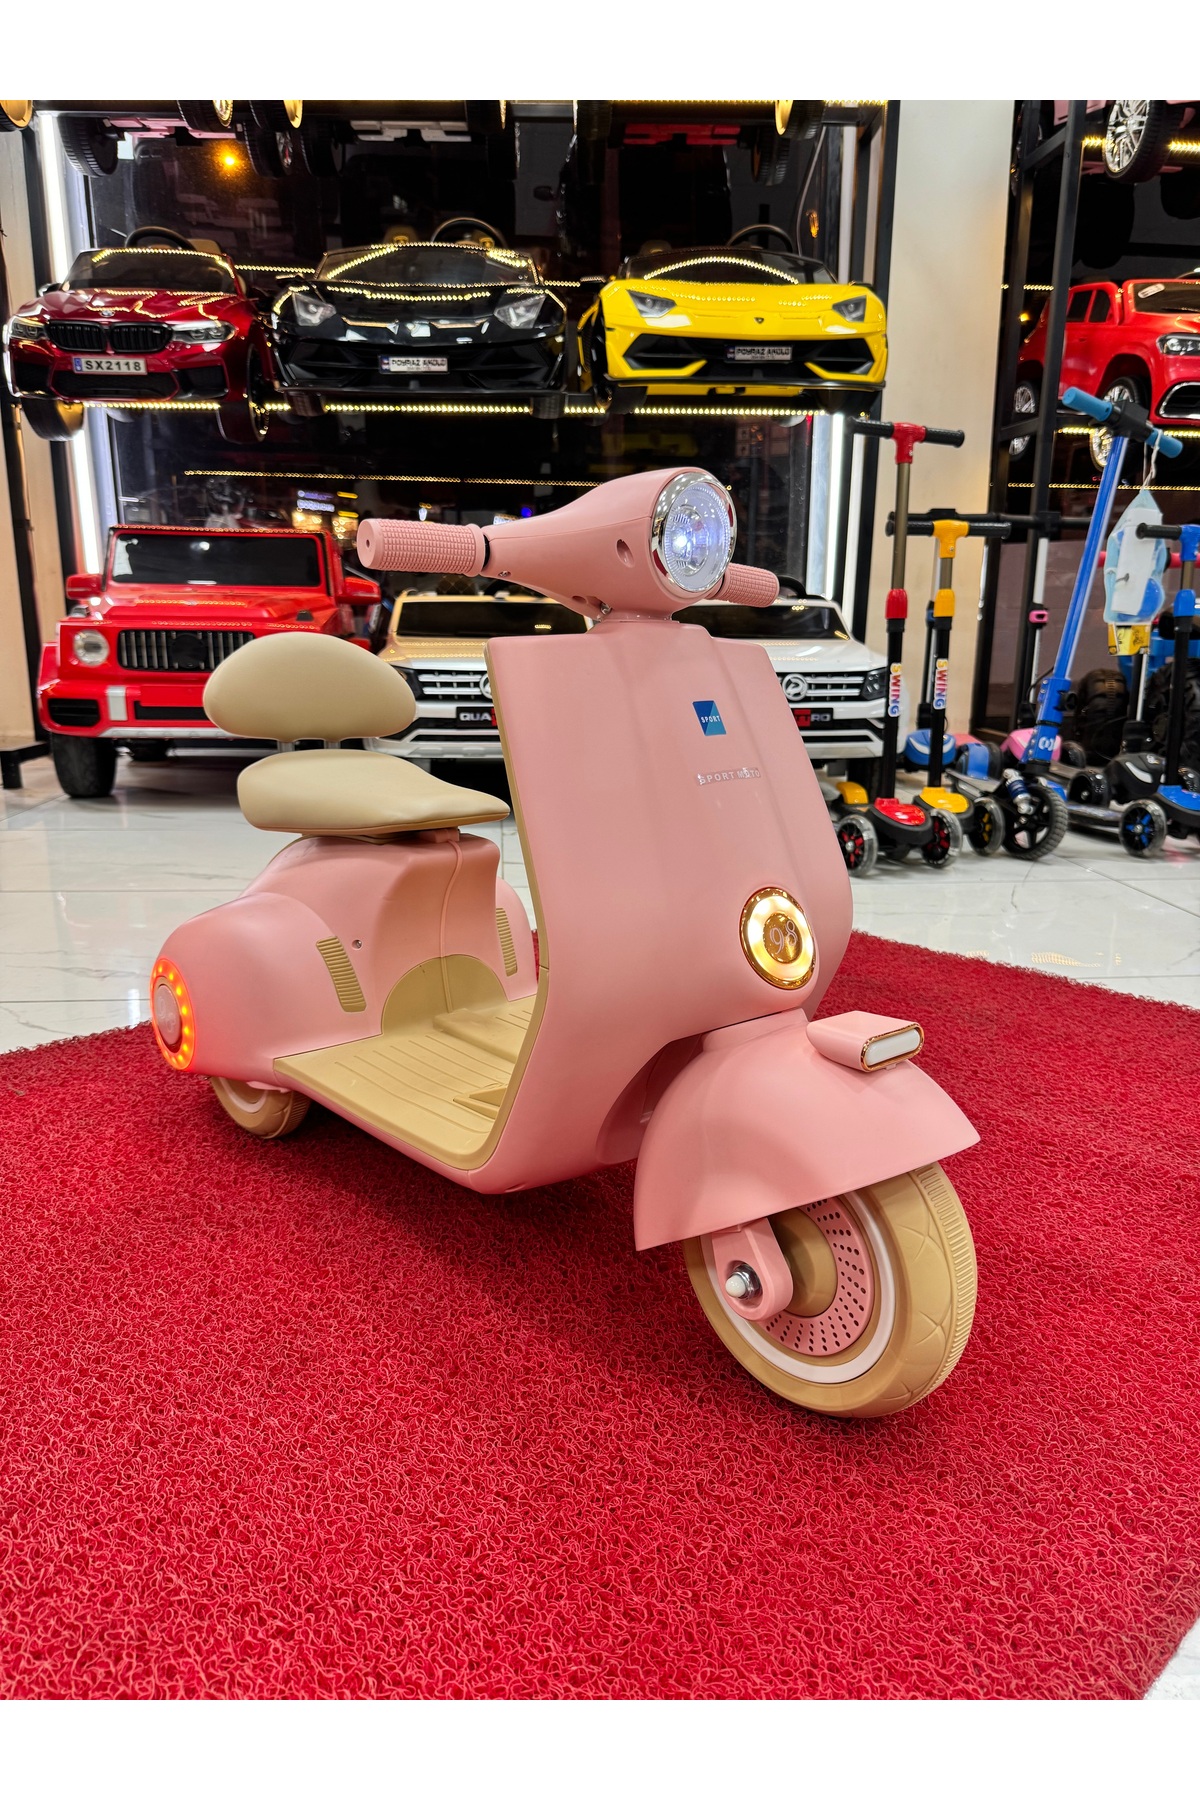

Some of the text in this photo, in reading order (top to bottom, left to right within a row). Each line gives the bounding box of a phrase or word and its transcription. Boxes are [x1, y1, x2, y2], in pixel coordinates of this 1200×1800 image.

[85, 360, 141, 371] SX2118
[888, 664, 902, 717] SWING
[933, 659, 948, 709] SWING
[701, 715, 720, 723] SPORT
[698, 767, 760, 785] SPORT MOTO
[769, 920, 798, 954] 98
